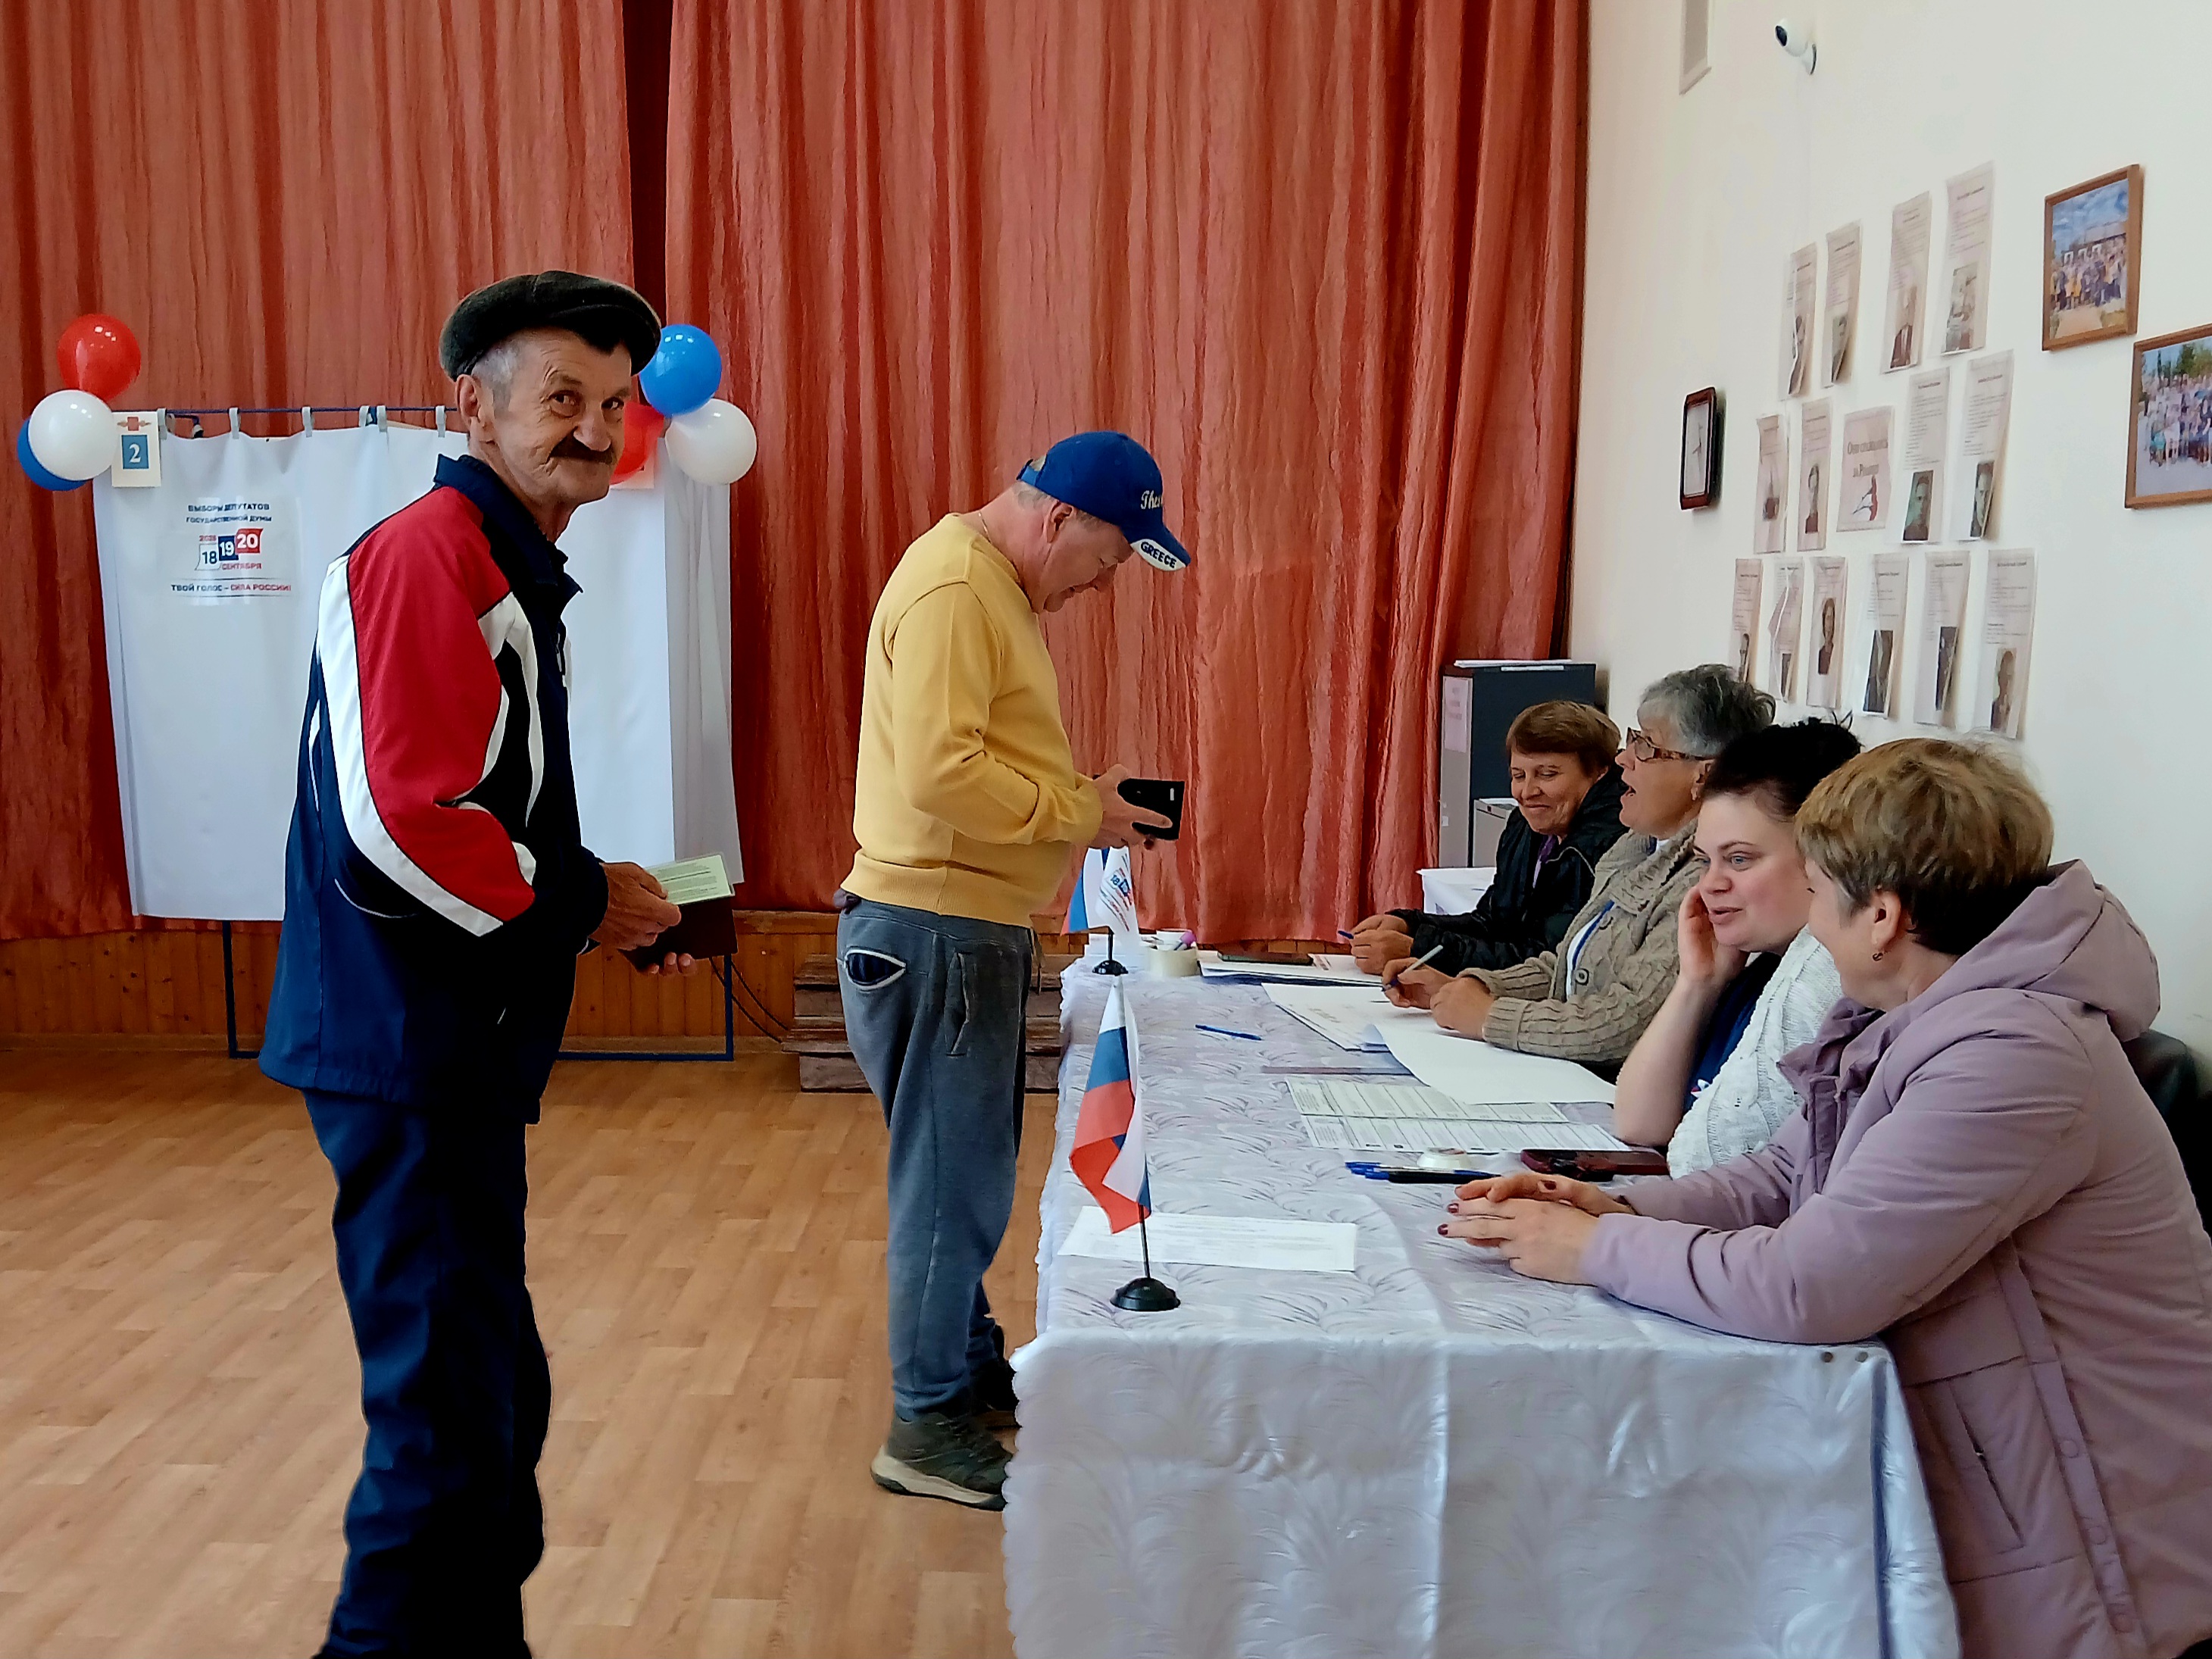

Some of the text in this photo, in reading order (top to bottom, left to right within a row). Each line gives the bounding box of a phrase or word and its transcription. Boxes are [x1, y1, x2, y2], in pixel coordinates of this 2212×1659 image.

[129, 443, 142, 463] 2
[224, 503, 270, 511] ДЕПУТАТОВ
[236, 533, 258, 548] 20
[220, 541, 235, 557] 19
[1140, 541, 1177, 569] GREECE
[202, 551, 217, 564] 18
[170, 583, 195, 592] ТВОЙ
